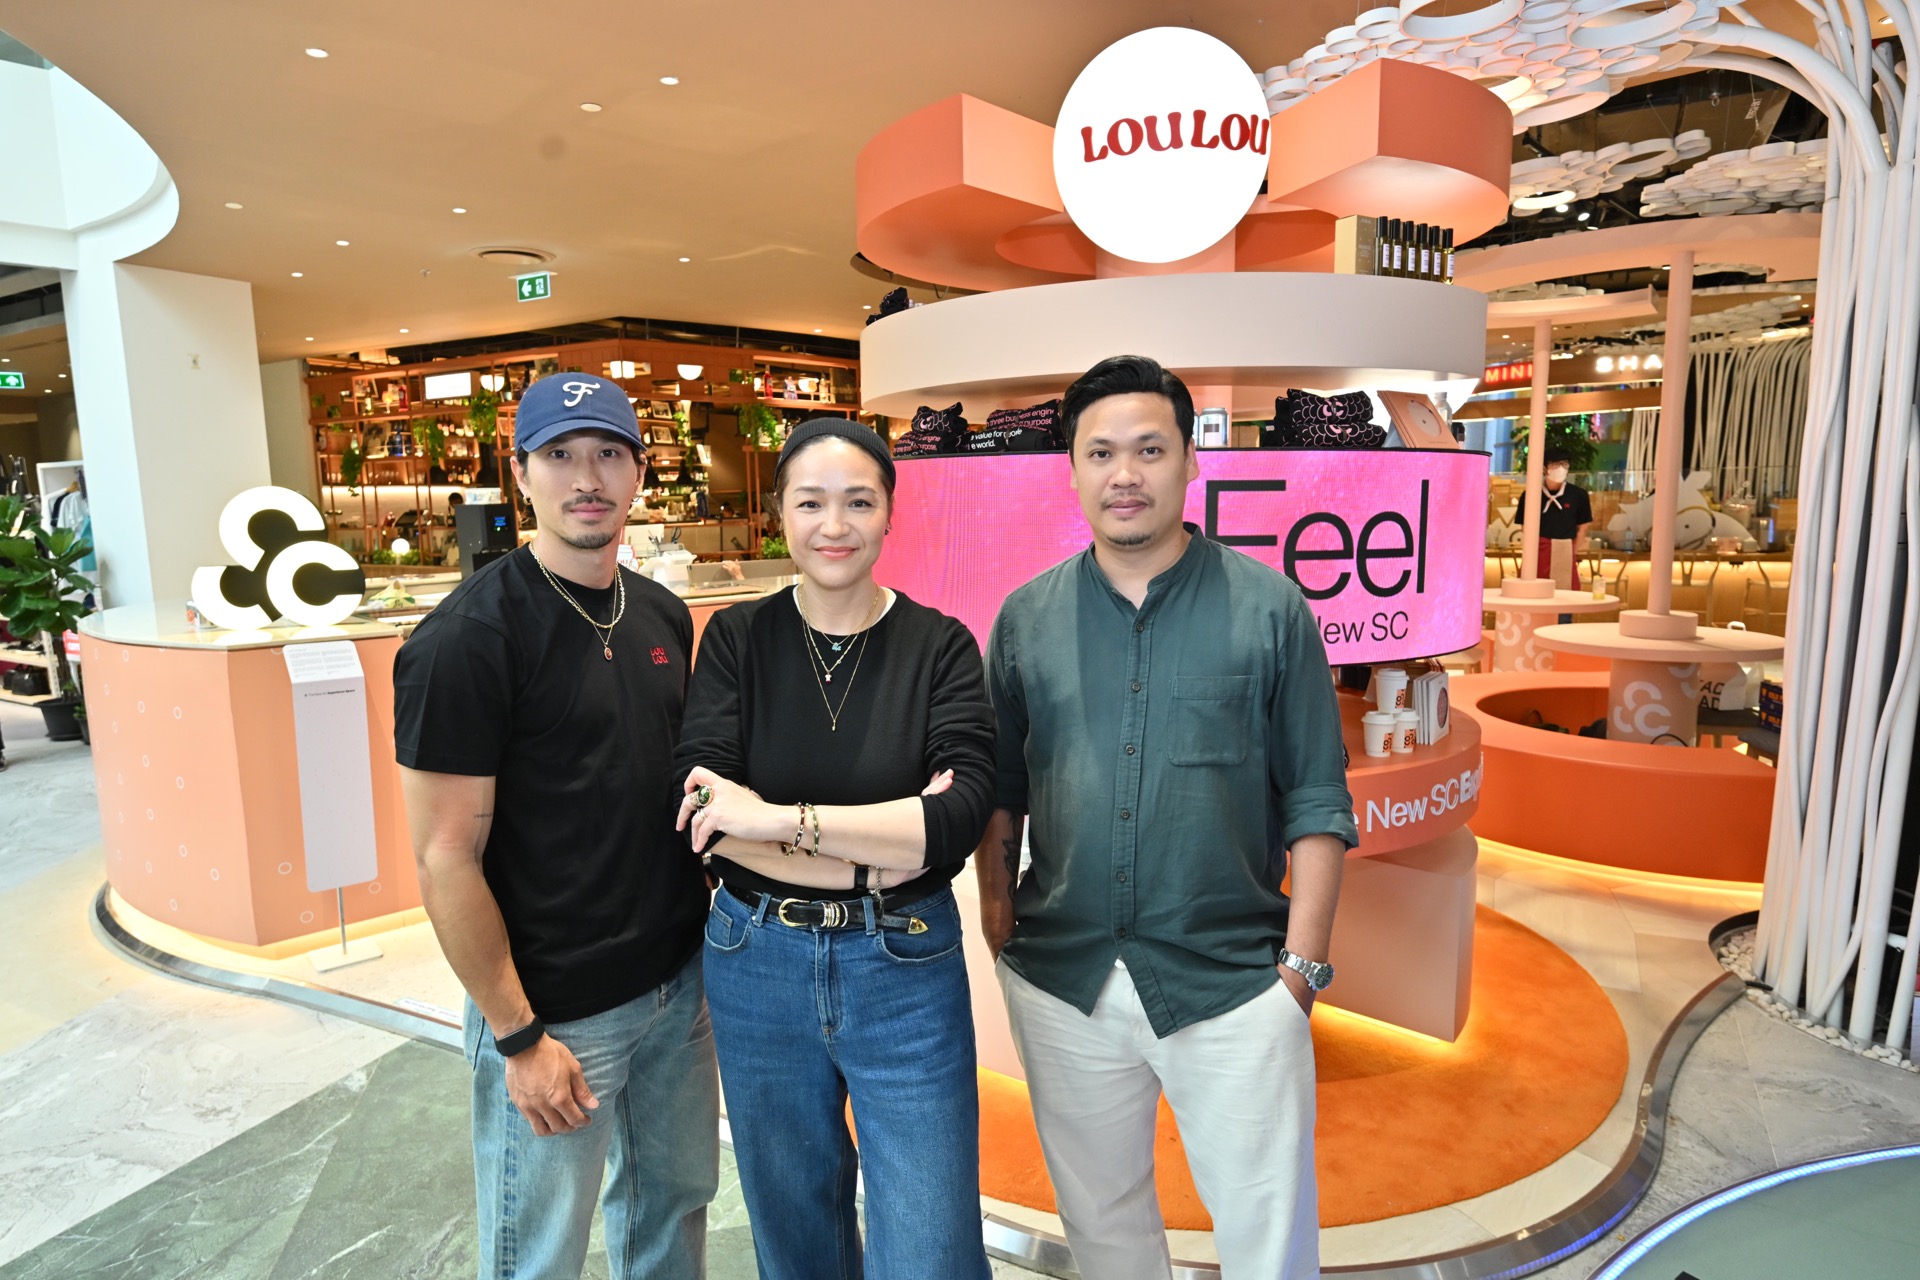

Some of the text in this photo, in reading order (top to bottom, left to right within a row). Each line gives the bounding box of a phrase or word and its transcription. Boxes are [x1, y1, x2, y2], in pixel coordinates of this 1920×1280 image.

[1081, 109, 1269, 162] LOU LOU
[1205, 479, 1430, 600] Feel
[1317, 611, 1409, 644] ew SC
[1367, 797, 1428, 832] New
[1430, 778, 1459, 816] SC
